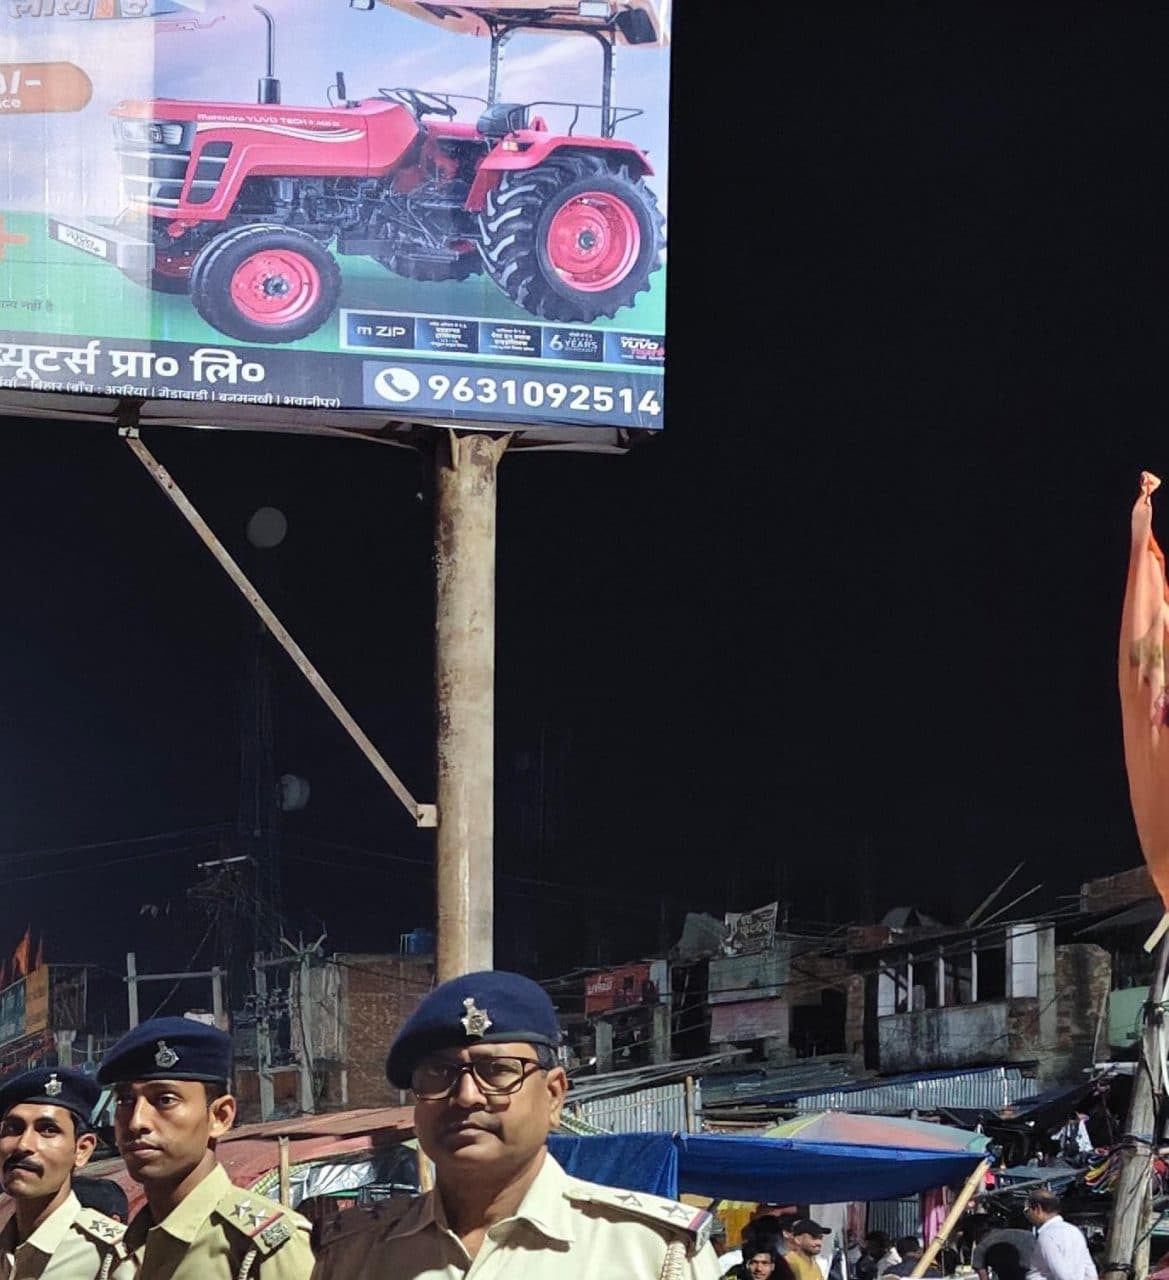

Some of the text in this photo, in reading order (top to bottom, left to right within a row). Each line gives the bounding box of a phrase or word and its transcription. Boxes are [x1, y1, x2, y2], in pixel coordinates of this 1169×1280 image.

[375, 326, 406, 338] ZIP
[565, 340, 598, 350] YEARS
[427, 374, 662, 416] 9631092514
